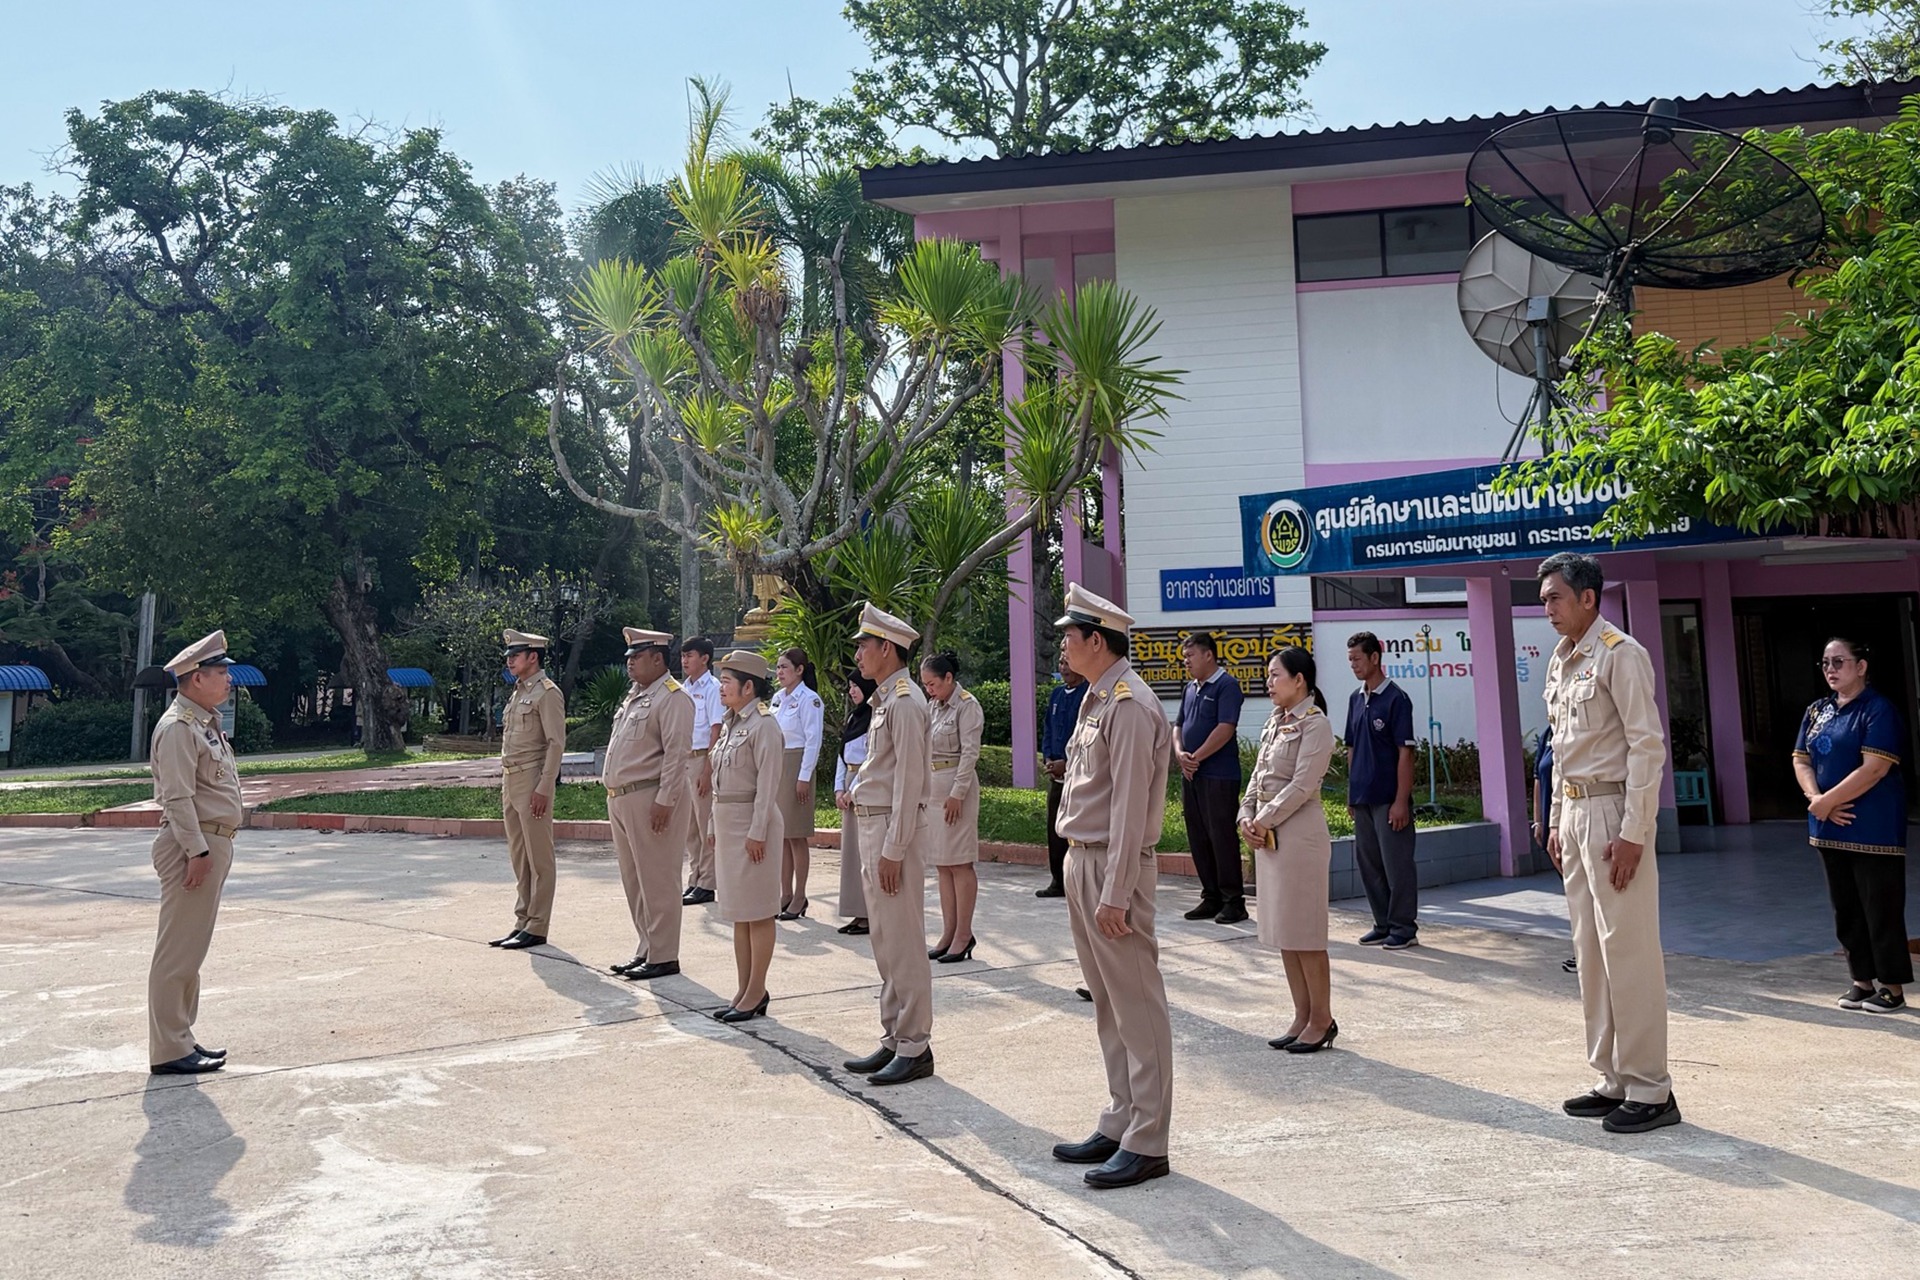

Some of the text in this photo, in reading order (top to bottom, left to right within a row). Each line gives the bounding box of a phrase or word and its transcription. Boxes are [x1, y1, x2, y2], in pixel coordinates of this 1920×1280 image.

[1365, 530, 1517, 558] กรมการพัฒนาชุมชน
[1166, 573, 1271, 599] อาคารอำนวยการ
